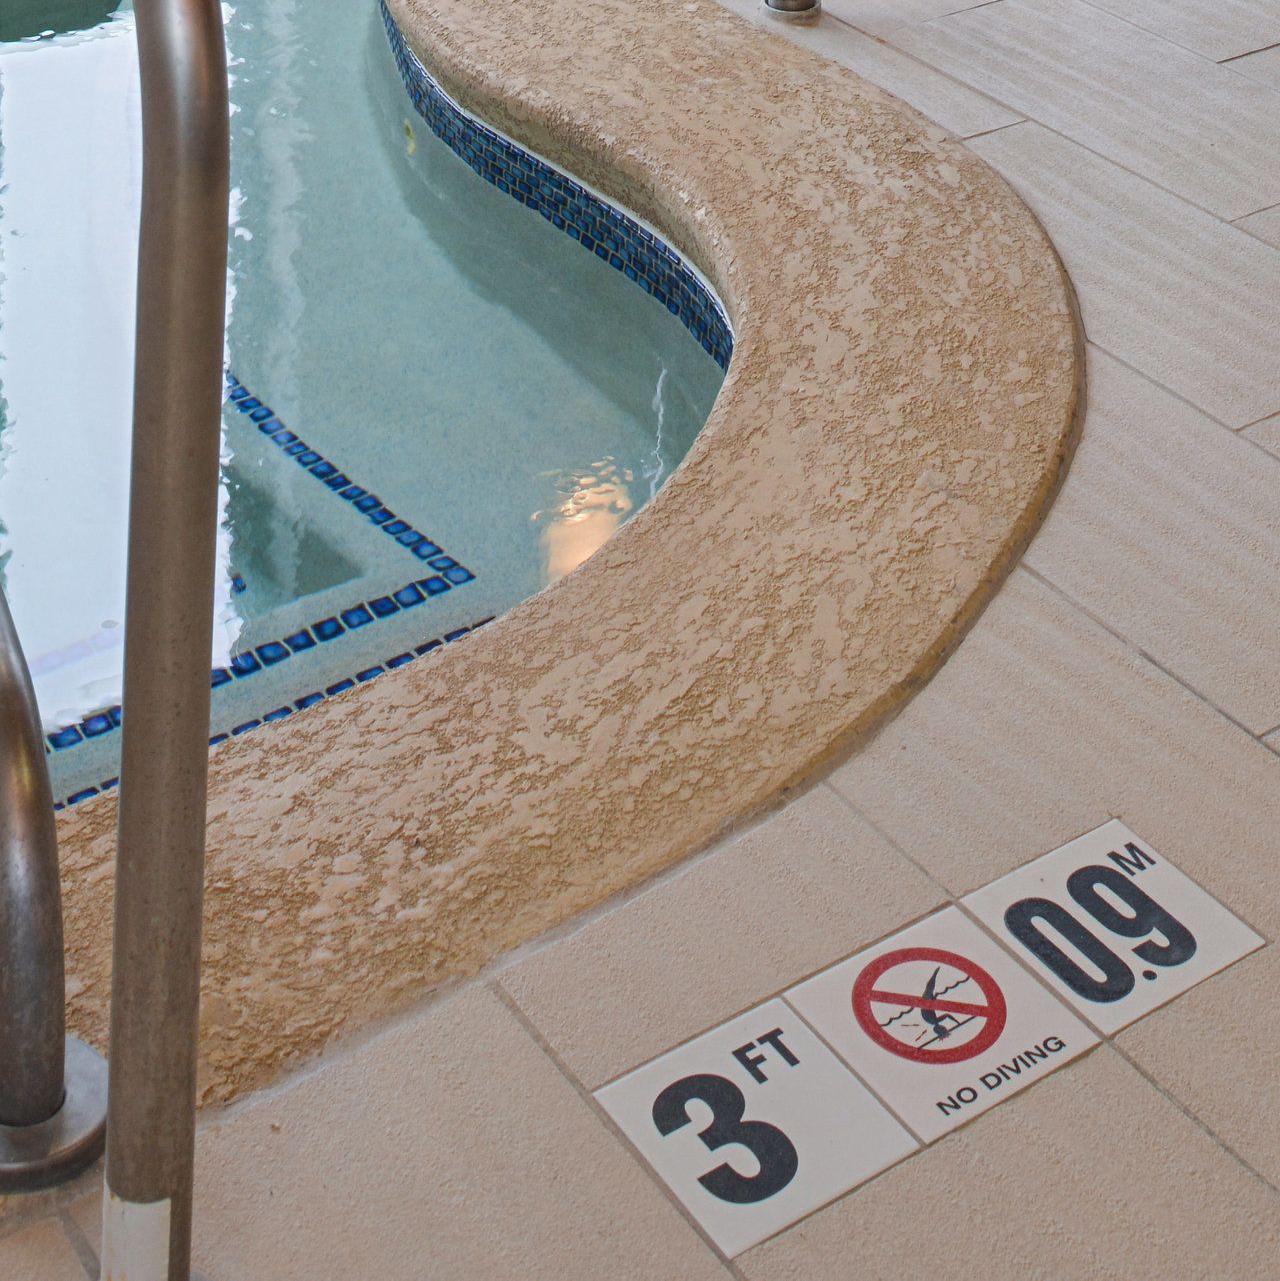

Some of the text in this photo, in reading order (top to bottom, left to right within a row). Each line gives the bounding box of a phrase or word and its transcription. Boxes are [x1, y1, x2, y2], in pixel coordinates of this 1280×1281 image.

[1004, 841, 1198, 1003] 0.9 M
[652, 1027, 801, 1205] 3 FT
[937, 1035, 1066, 1116] NO DIVING
